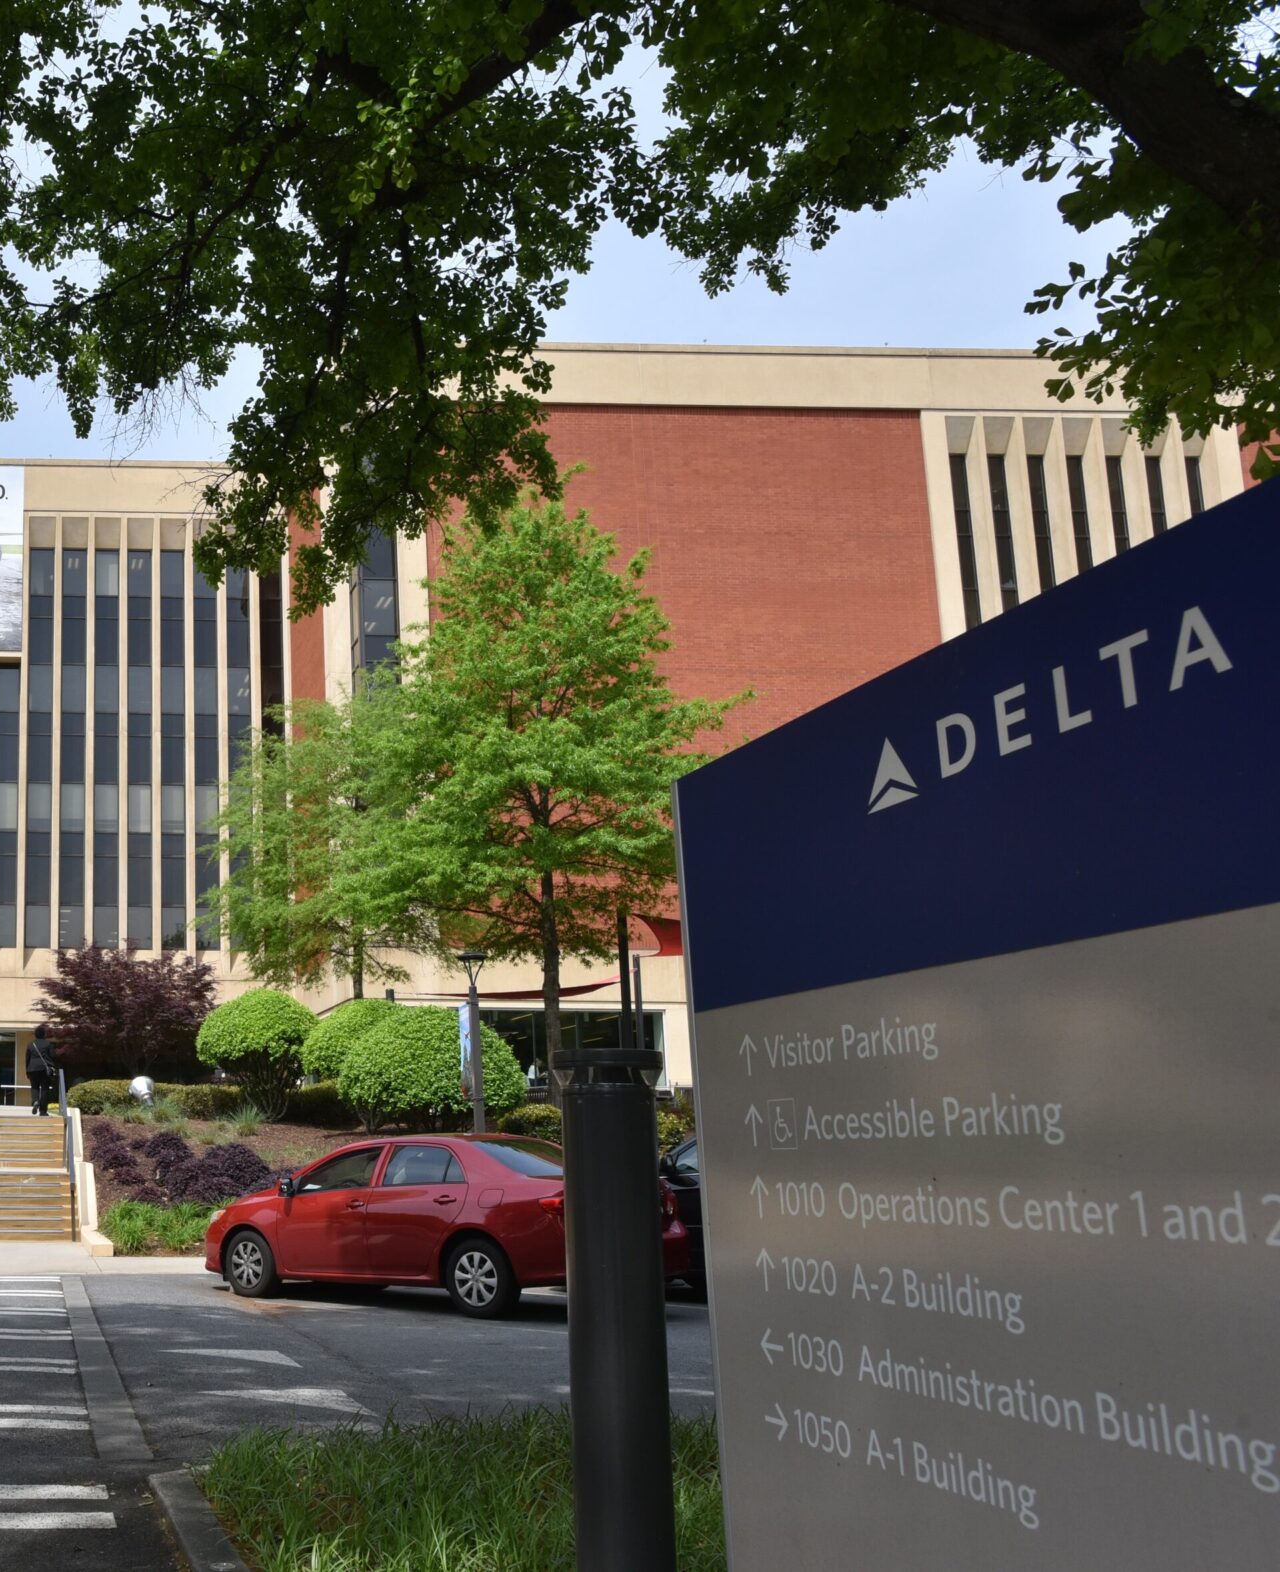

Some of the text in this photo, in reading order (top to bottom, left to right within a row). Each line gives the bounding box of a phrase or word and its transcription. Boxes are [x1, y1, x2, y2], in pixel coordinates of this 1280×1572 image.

[935, 605, 1233, 779] DELTA
[764, 1017, 939, 1069] Visitor Parking
[803, 1092, 1065, 1145] Accessible Parking
[776, 1182, 825, 1218] 1010
[838, 1182, 990, 1229] Operations
[999, 1185, 1119, 1235] Center
[1129, 1190, 1148, 1238] 1
[1162, 1190, 1248, 1245] and
[781, 1256, 1026, 1335] 1020 A-2 Building
[787, 1331, 1280, 1493] 1030 Administration Building
[793, 1408, 1040, 1530] 1050 A-1 Building
